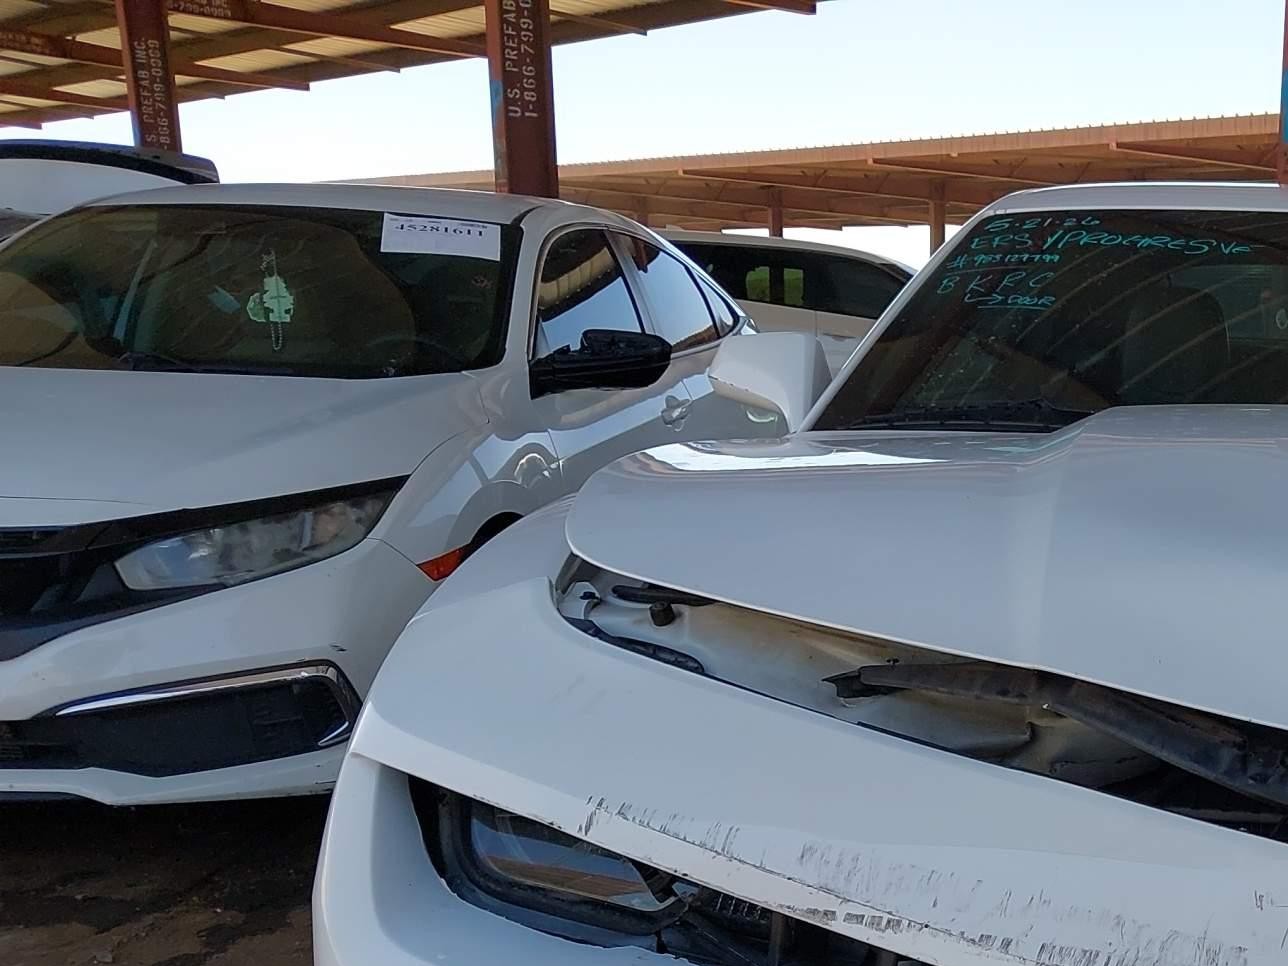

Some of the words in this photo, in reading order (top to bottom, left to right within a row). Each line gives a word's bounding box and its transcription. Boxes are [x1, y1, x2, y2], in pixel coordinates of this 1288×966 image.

[502, 0, 520, 72] PREFAB
[136, 70, 155, 123] PREFAB
[394, 223, 484, 237] 45281611
